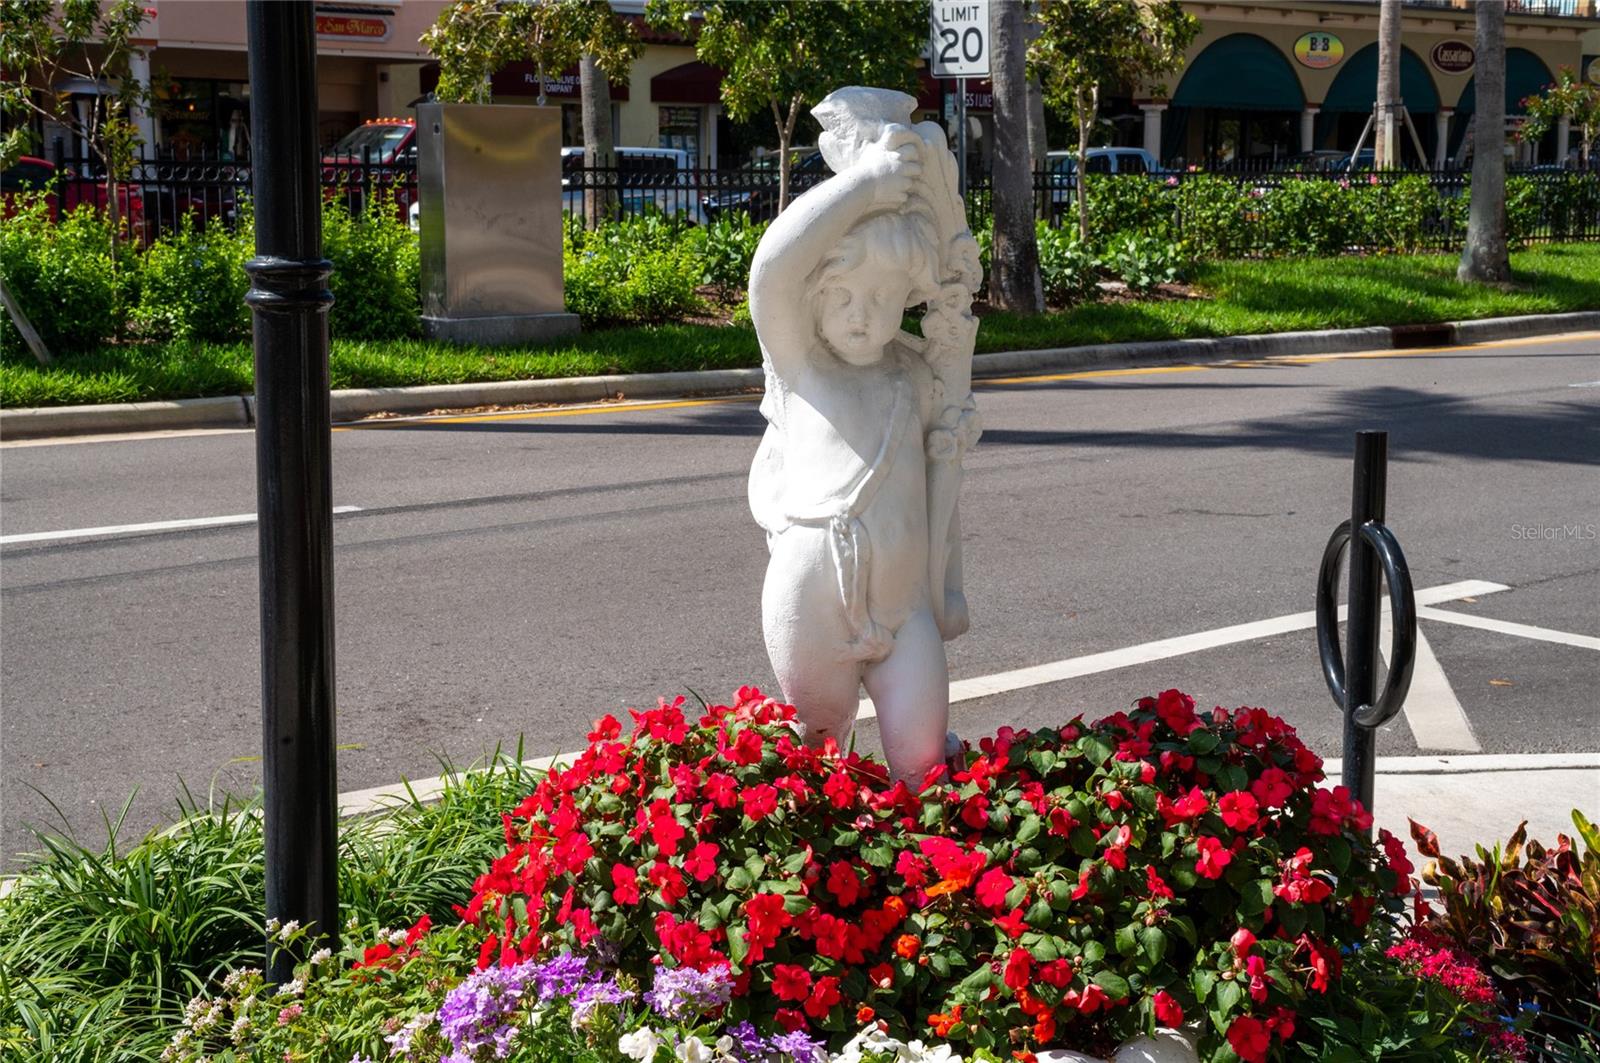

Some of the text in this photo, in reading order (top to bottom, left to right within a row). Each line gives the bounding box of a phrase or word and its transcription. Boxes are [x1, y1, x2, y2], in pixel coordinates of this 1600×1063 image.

[942, 6, 980, 22] LIMIT
[940, 27, 983, 63] 20
[544, 84, 573, 93] OMPANY
